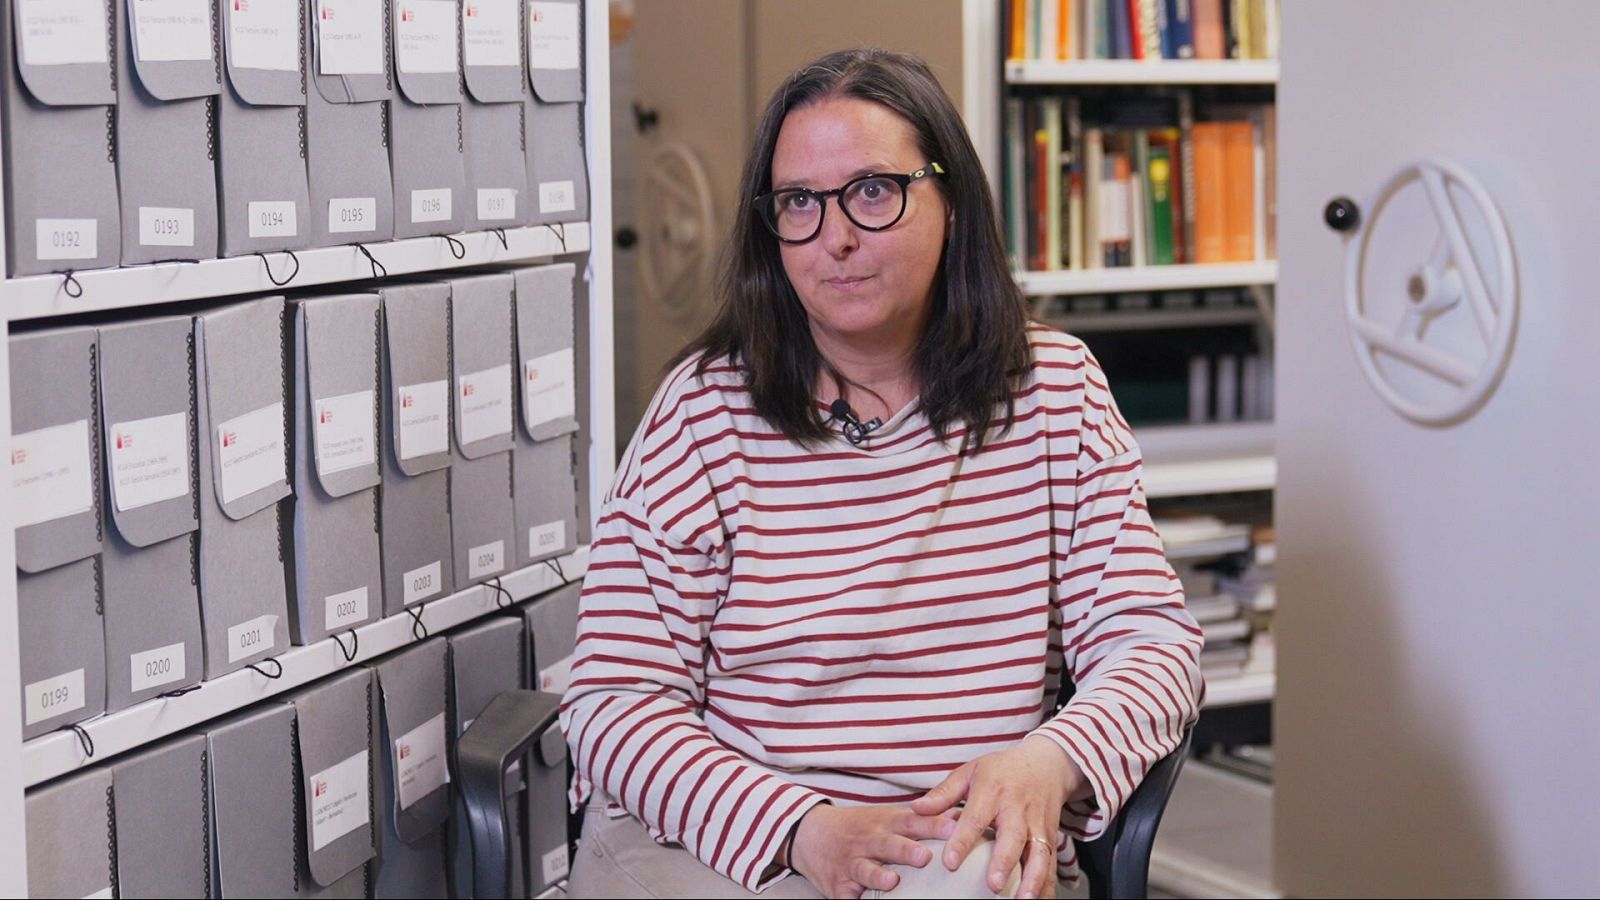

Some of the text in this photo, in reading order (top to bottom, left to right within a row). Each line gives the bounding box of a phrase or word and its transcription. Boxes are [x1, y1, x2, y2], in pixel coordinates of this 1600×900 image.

[422, 198, 441, 213] 0196
[487, 198, 505, 212] 0197
[261, 211, 284, 227] 0194
[341, 207, 363, 223] 0195
[154, 218, 180, 236] 0193
[52, 231, 81, 248] 0192
[478, 552, 496, 569] 0204
[413, 574, 432, 593] 0203
[336, 600, 357, 618] 0202
[240, 629, 261, 649] 0201
[145, 657, 171, 678] 0200
[41, 686, 69, 709] 0199
